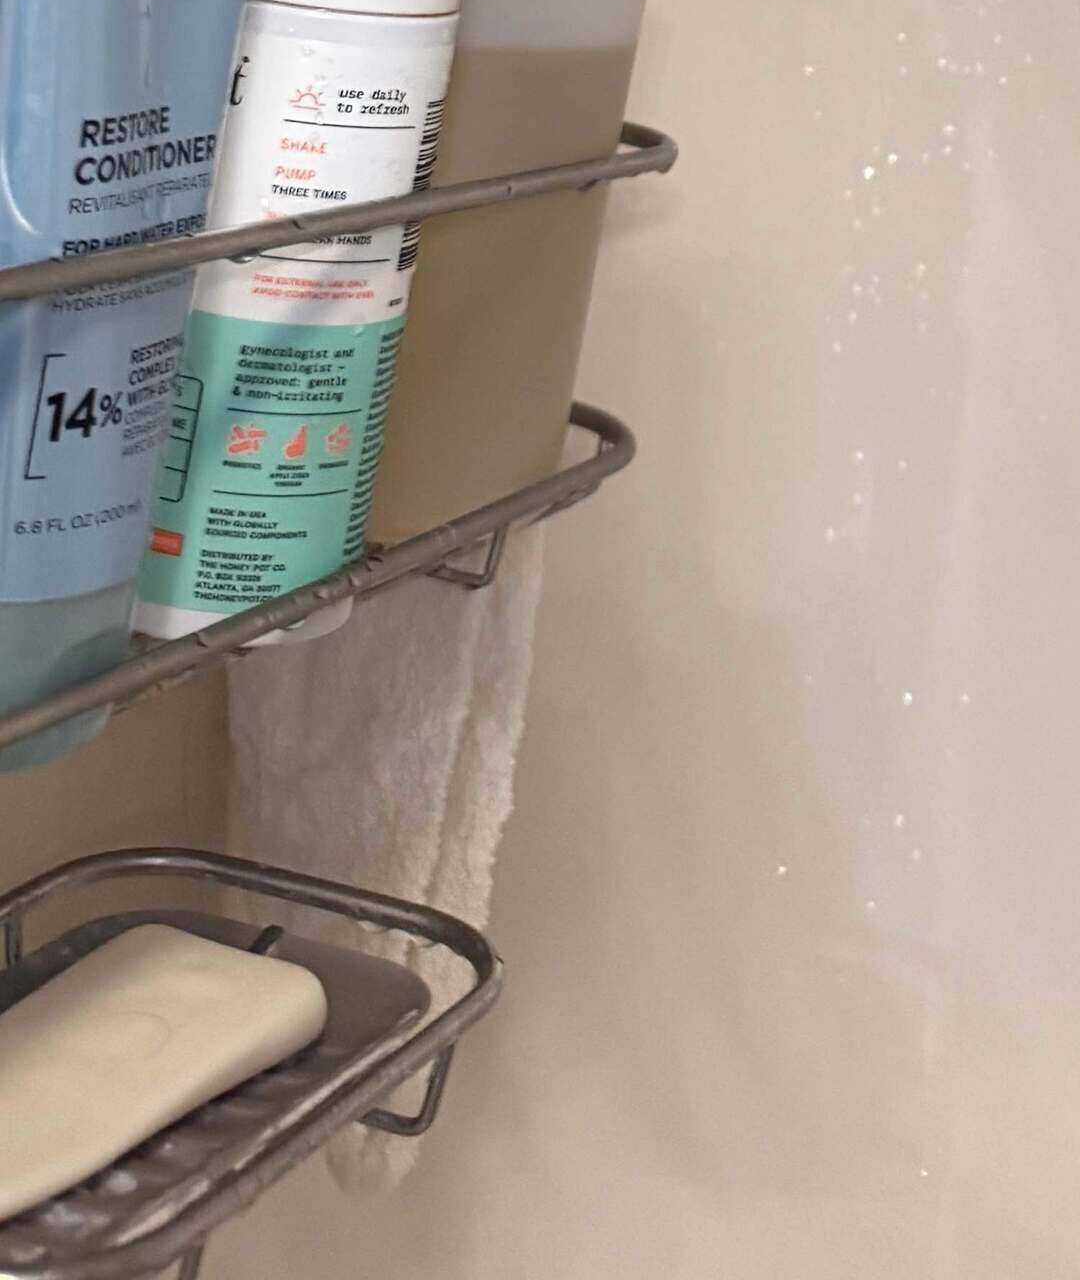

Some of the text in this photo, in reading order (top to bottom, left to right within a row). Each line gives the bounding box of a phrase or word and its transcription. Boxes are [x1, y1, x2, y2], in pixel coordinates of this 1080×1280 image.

[338, 89, 407, 104] use daily
[337, 102, 410, 116] to refresh
[80, 106, 171, 148] RESTORE
[281, 137, 329, 154] SHAKE
[75, 134, 216, 186] CONDITIONER
[274, 165, 316, 181] PUMP
[271, 184, 348, 201] THREE TIMES
[240, 344, 328, 361] gynecologist
[129, 356, 175, 387] COMPLE
[238, 359, 333, 375] dermatologist
[307, 376, 348, 390] gentle
[47, 386, 123, 443] 14%
